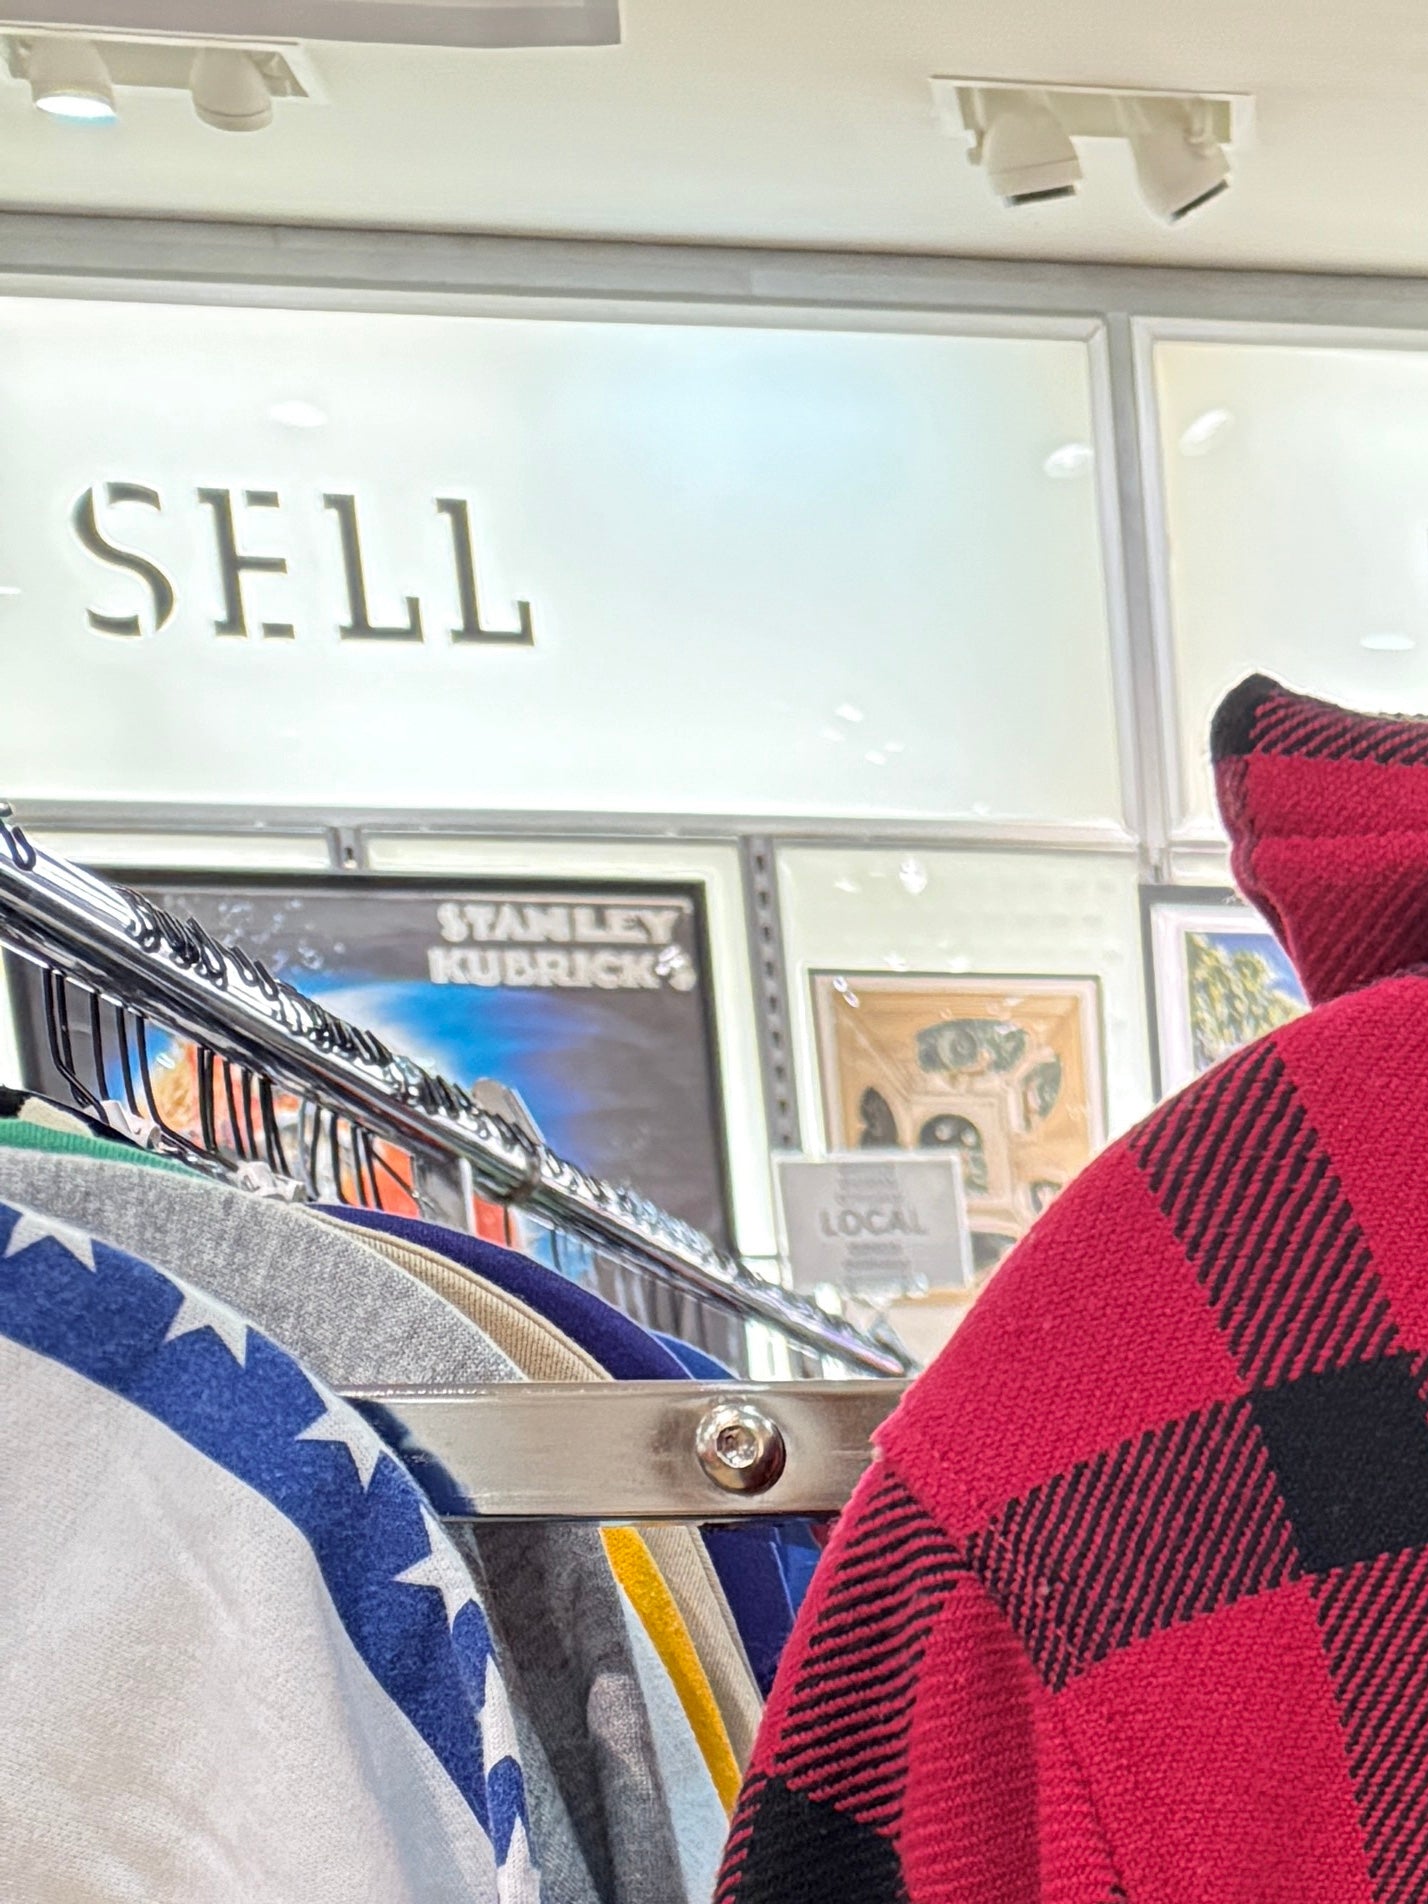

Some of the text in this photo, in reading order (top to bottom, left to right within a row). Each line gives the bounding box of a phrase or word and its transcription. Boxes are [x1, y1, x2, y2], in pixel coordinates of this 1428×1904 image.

[72, 481, 535, 647] SELL
[437, 903, 679, 944] STANLEY
[427, 945, 696, 991] KUBRICKS
[819, 1204, 929, 1237] LOCAL
